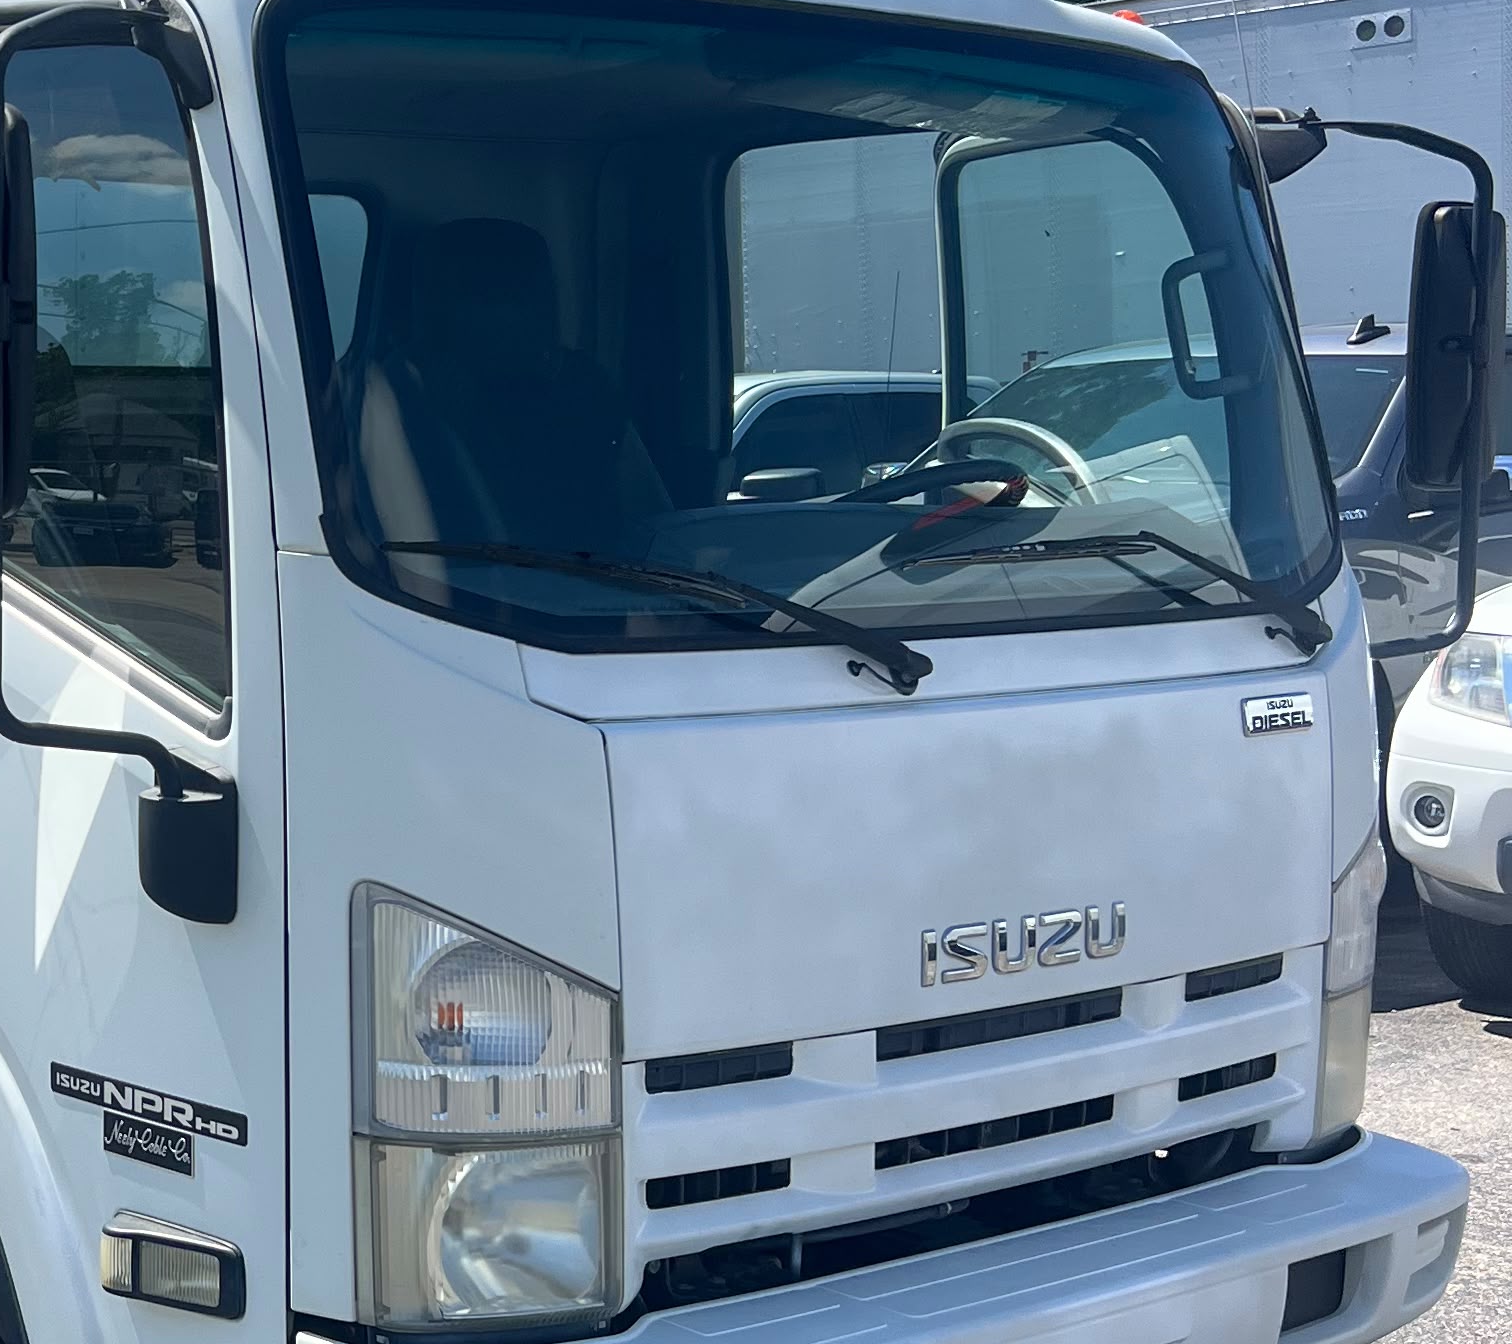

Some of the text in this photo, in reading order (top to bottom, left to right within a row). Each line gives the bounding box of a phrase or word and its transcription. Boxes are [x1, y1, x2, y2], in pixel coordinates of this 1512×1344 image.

[1251, 710, 1313, 731] DIESEL
[1266, 698, 1294, 710] ISUZU
[920, 901, 1126, 987] ISUZU
[56, 1072, 239, 1140] ISUZU NPR HD
[104, 1119, 137, 1154] Neely
